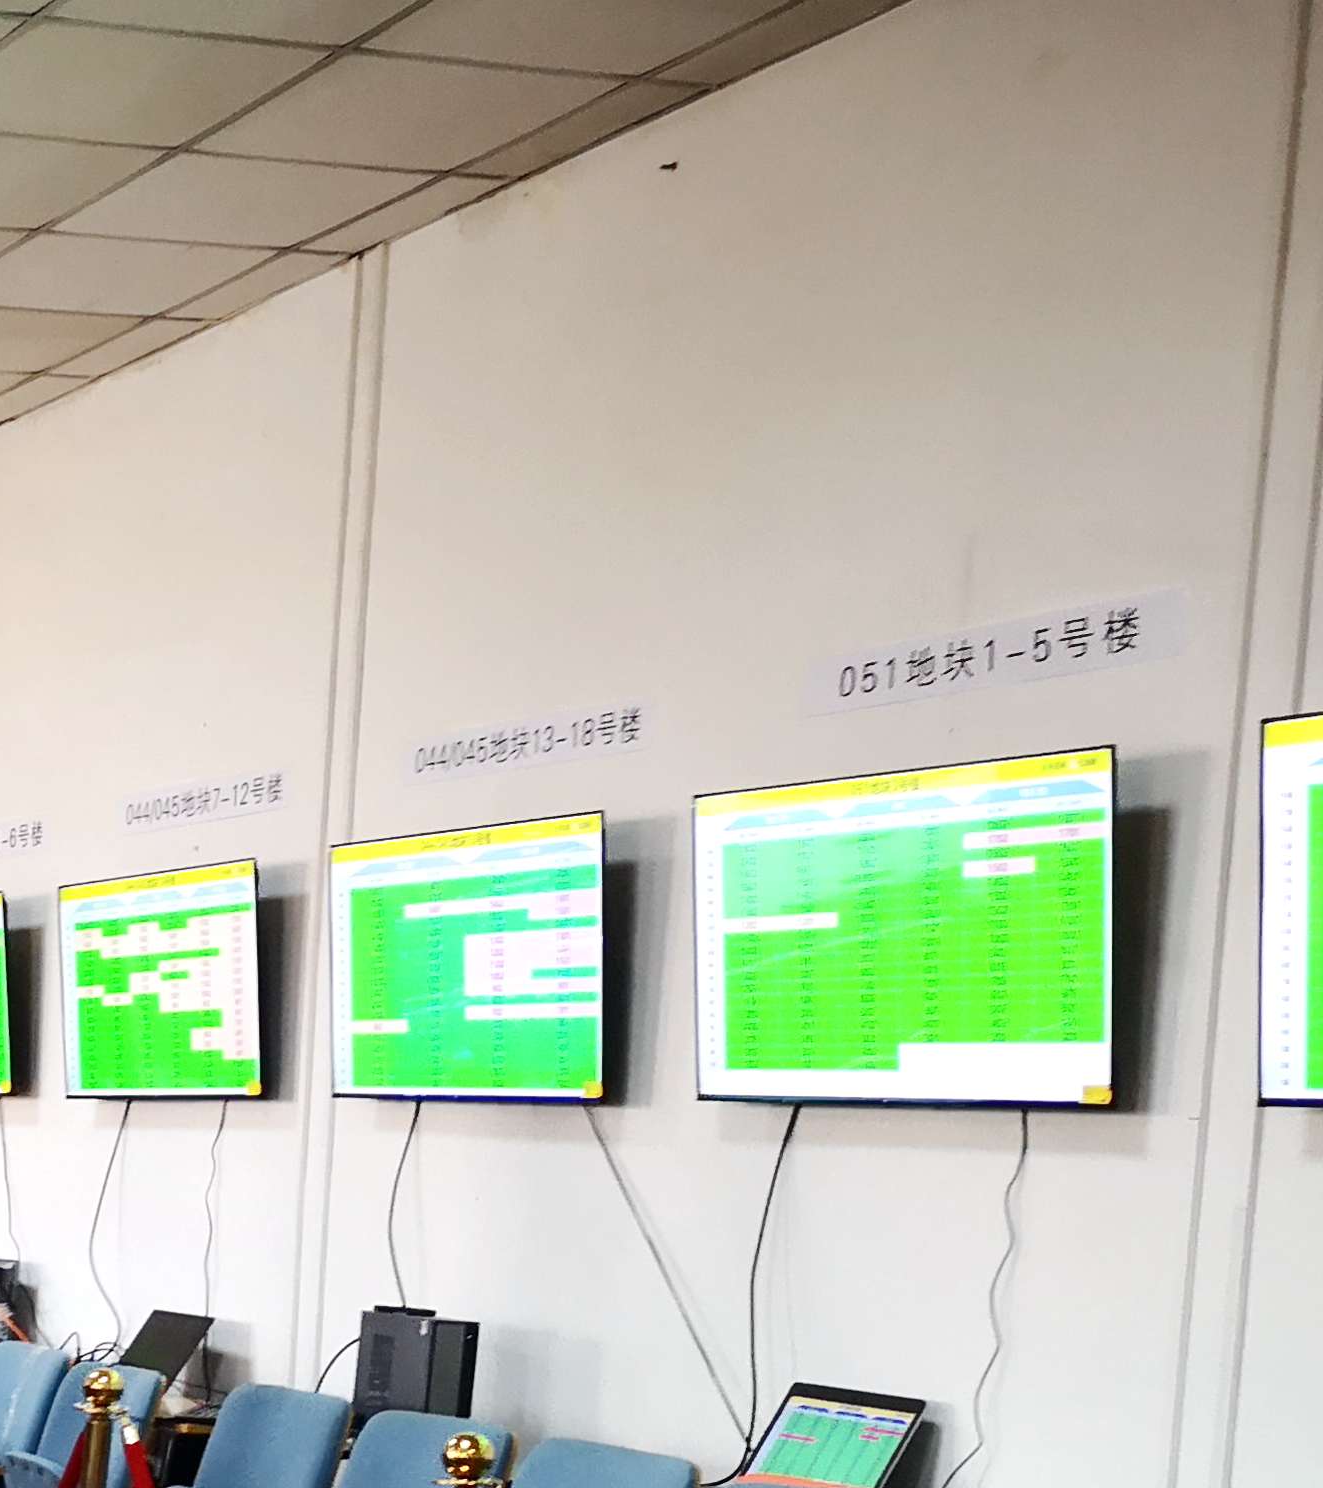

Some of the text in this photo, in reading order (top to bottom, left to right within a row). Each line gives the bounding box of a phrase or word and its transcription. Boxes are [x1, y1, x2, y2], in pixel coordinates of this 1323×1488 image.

[837, 607, 1141, 698] 051地块1-5号楼
[413, 706, 642, 775] 044/045地块13-18号楼
[125, 772, 284, 826] 044/045地块7-12号楼
